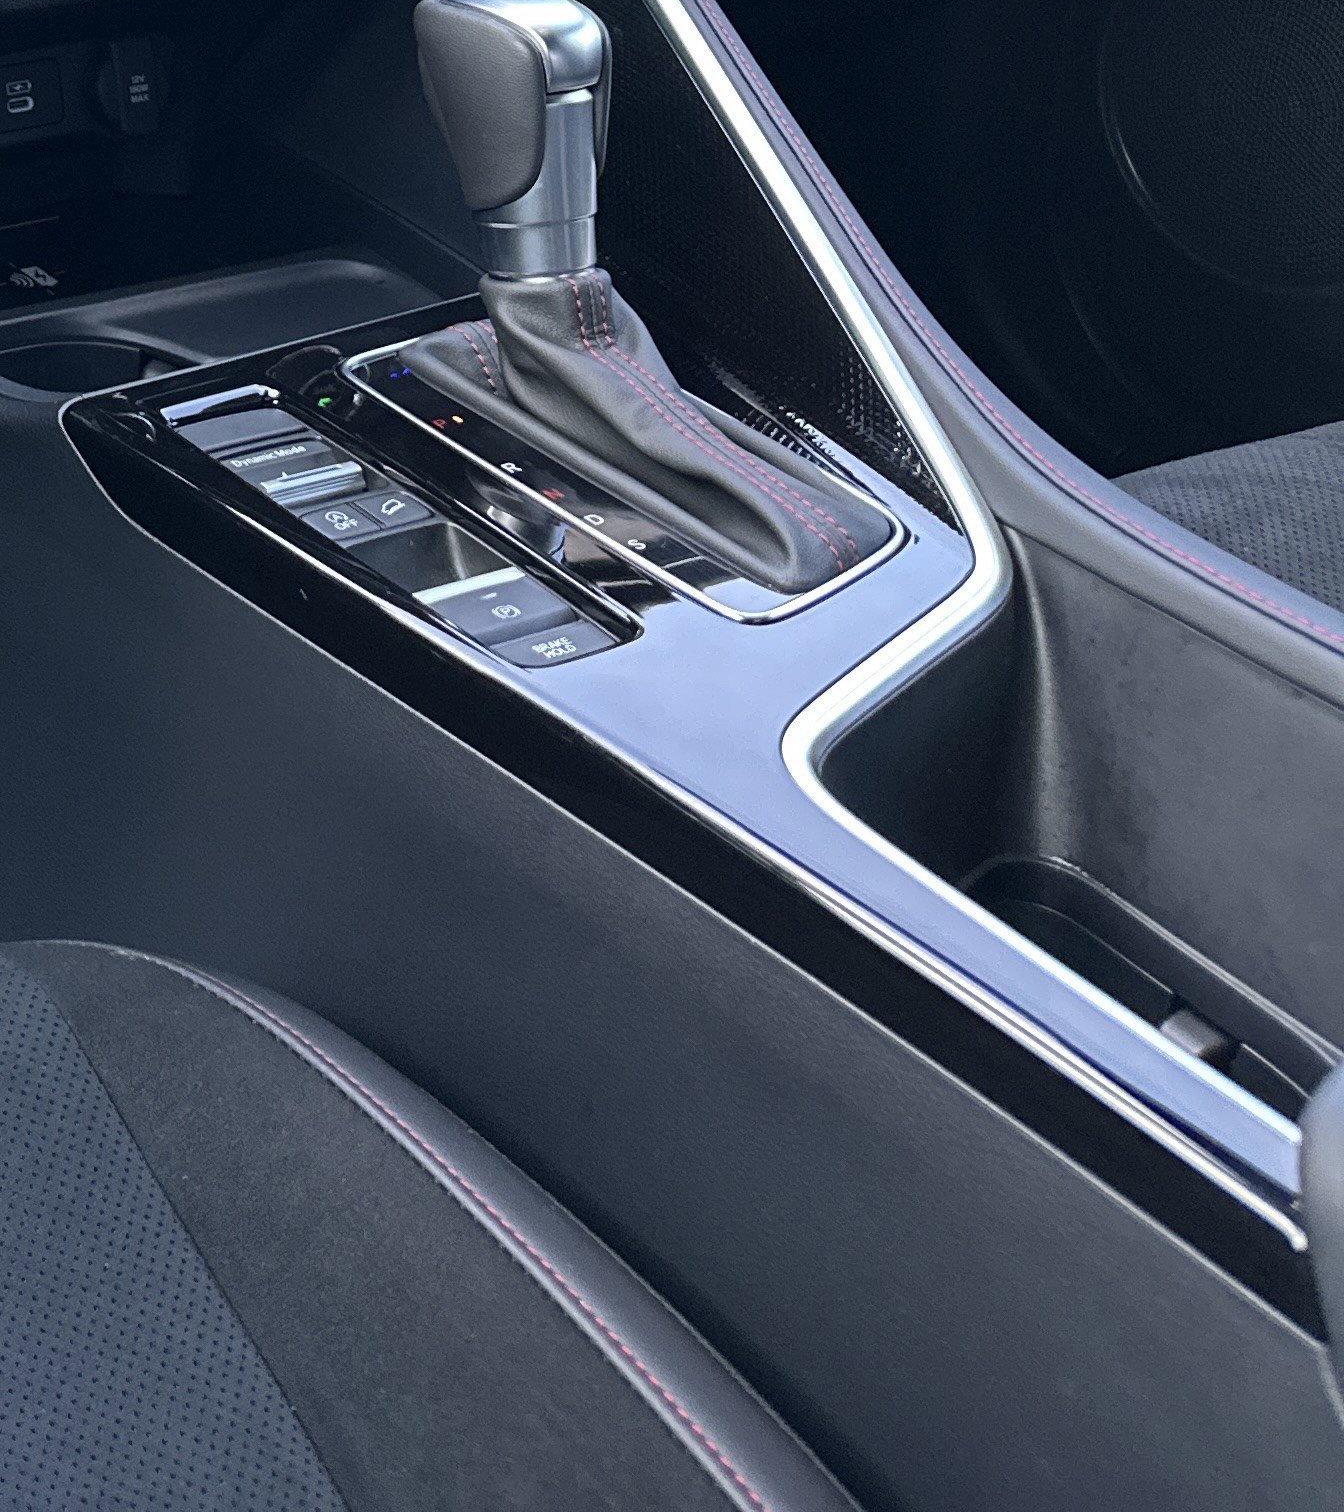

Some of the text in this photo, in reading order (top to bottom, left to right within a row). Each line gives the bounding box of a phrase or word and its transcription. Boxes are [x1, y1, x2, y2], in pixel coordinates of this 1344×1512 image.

[431, 418, 446, 430] P
[230, 445, 307, 469] Dynamic Mode
[500, 461, 522, 474] R
[542, 488, 565, 501] N
[583, 513, 604, 526] D
[628, 538, 647, 551] S
[532, 636, 573, 653] BRAKE
[543, 644, 577, 659] HOLD
